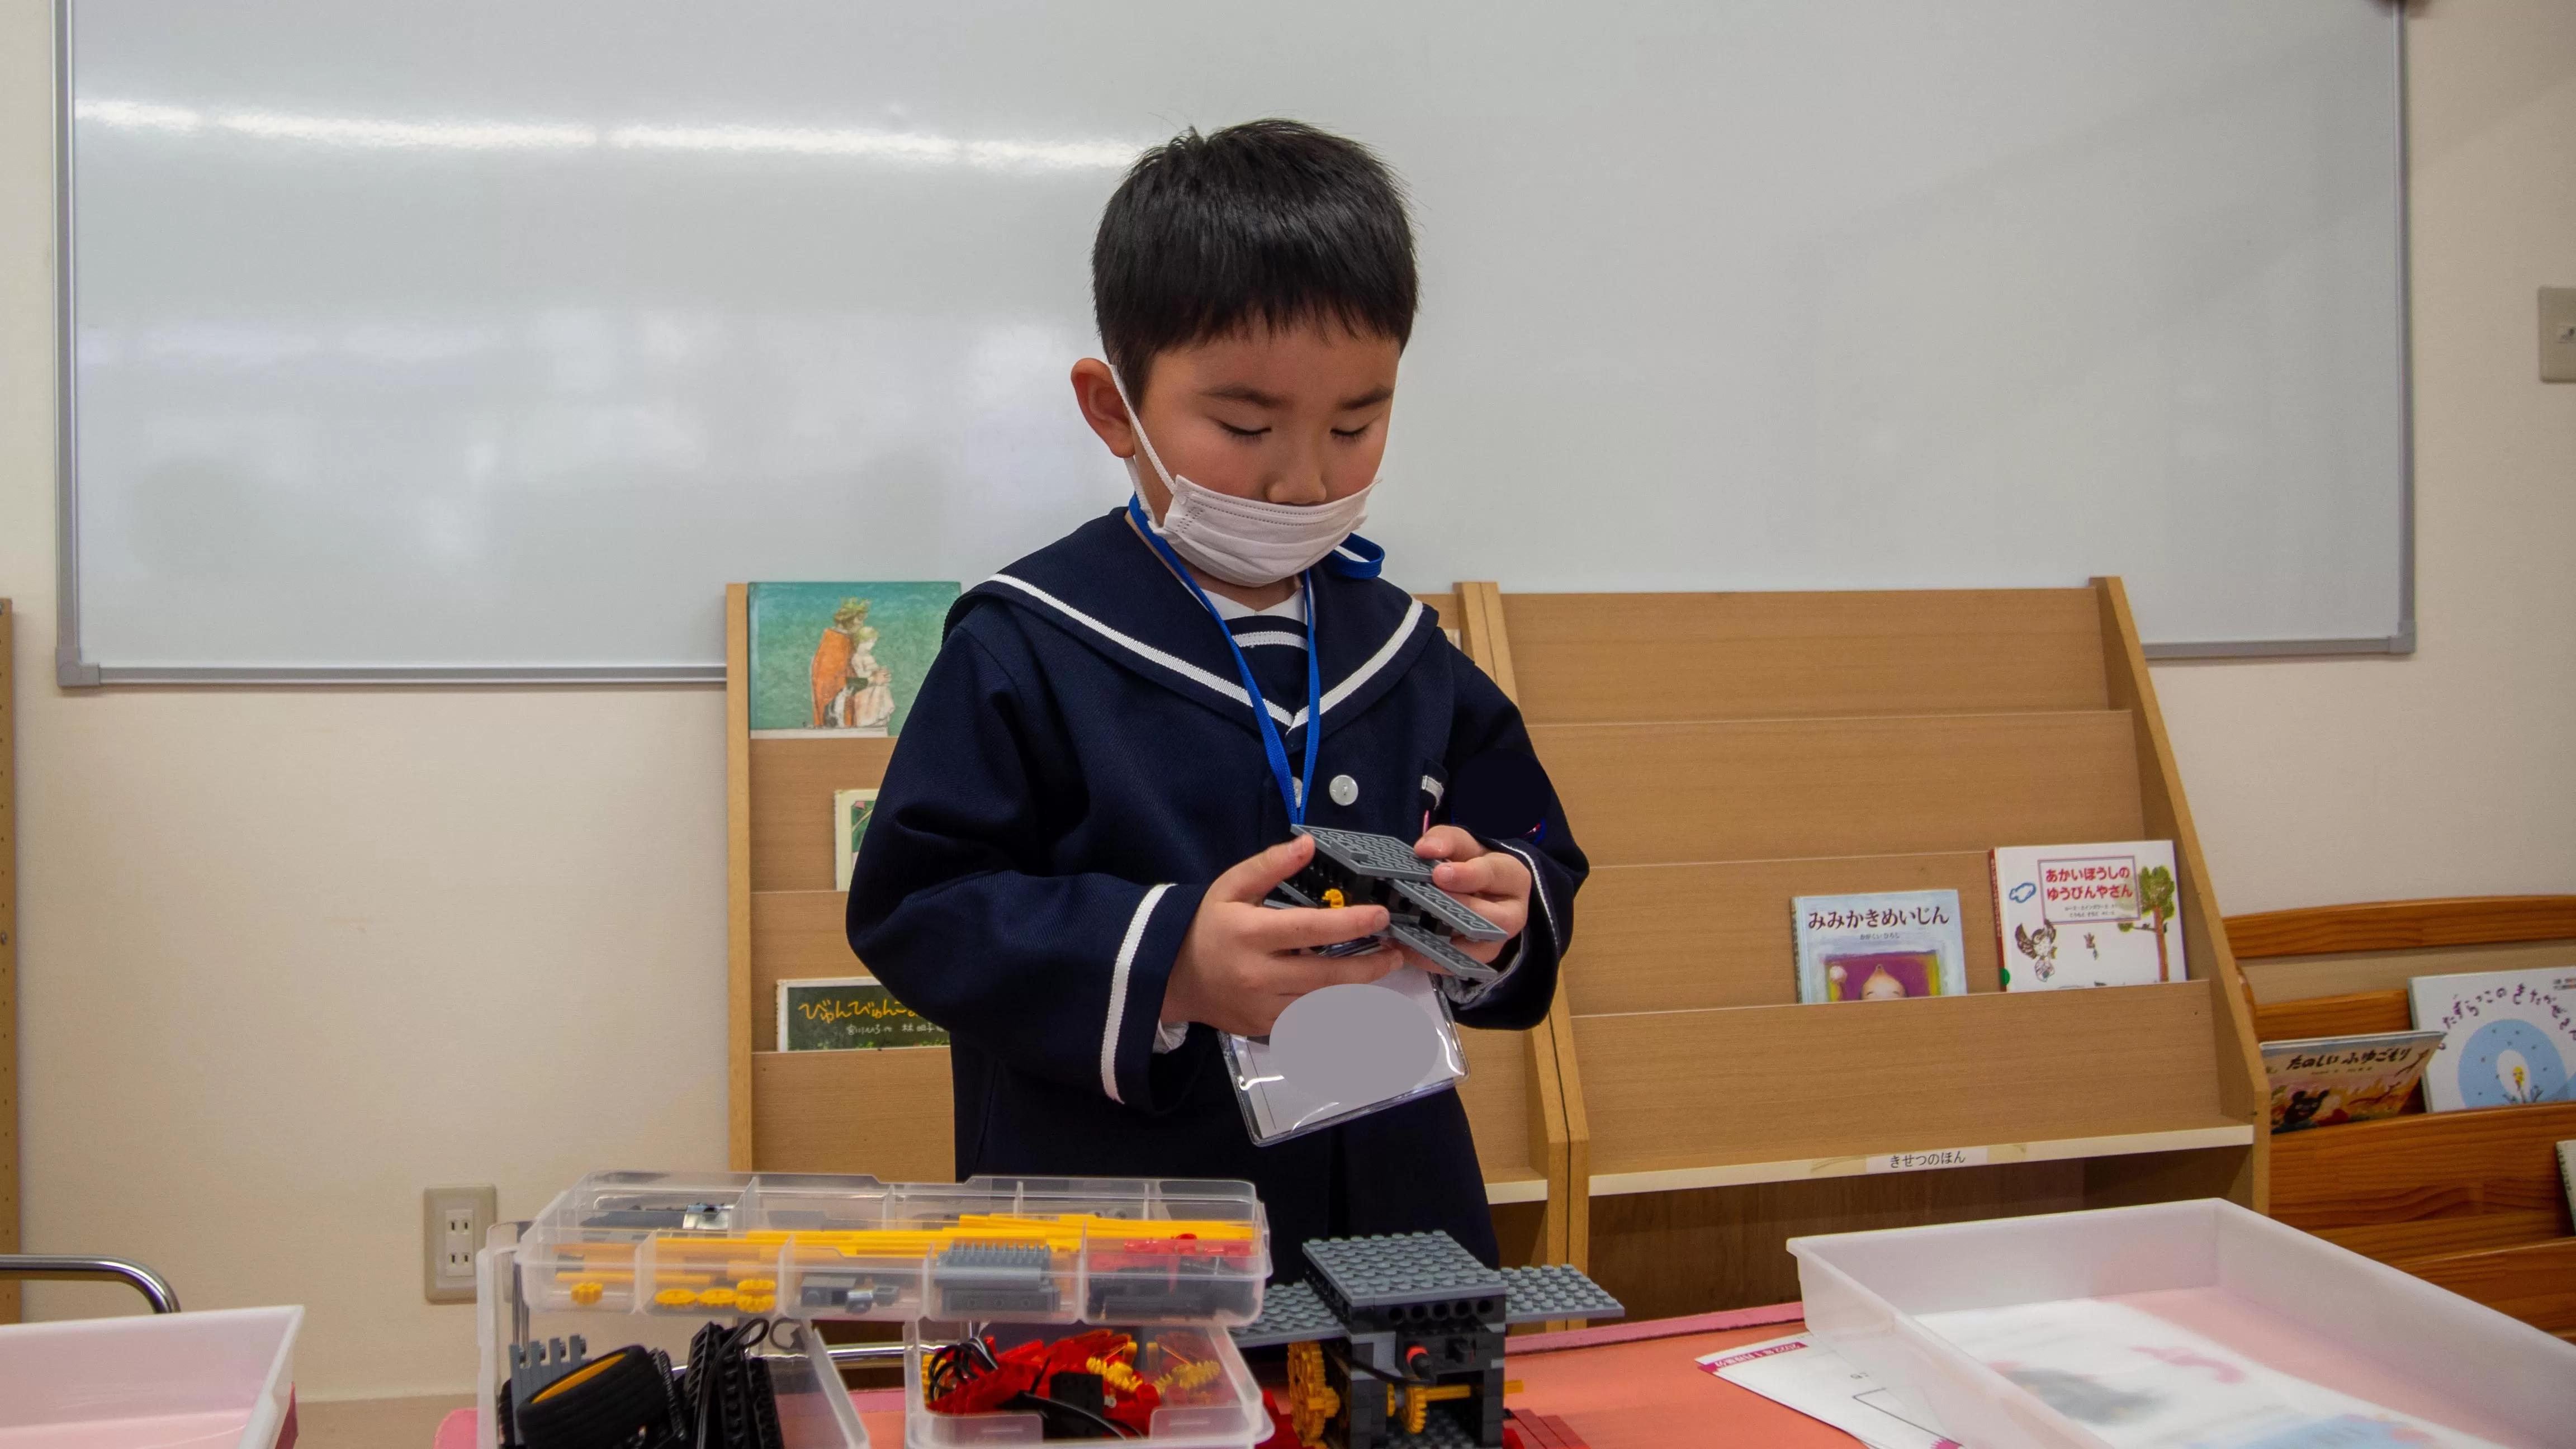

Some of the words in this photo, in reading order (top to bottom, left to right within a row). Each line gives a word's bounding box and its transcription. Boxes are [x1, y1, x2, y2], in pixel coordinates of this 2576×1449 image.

[2047, 884, 2133, 901] ゆうびんやさん
[1808, 906, 1950, 931] みみかきめいじん
[1890, 1150, 1966, 1168] きせつのほん
